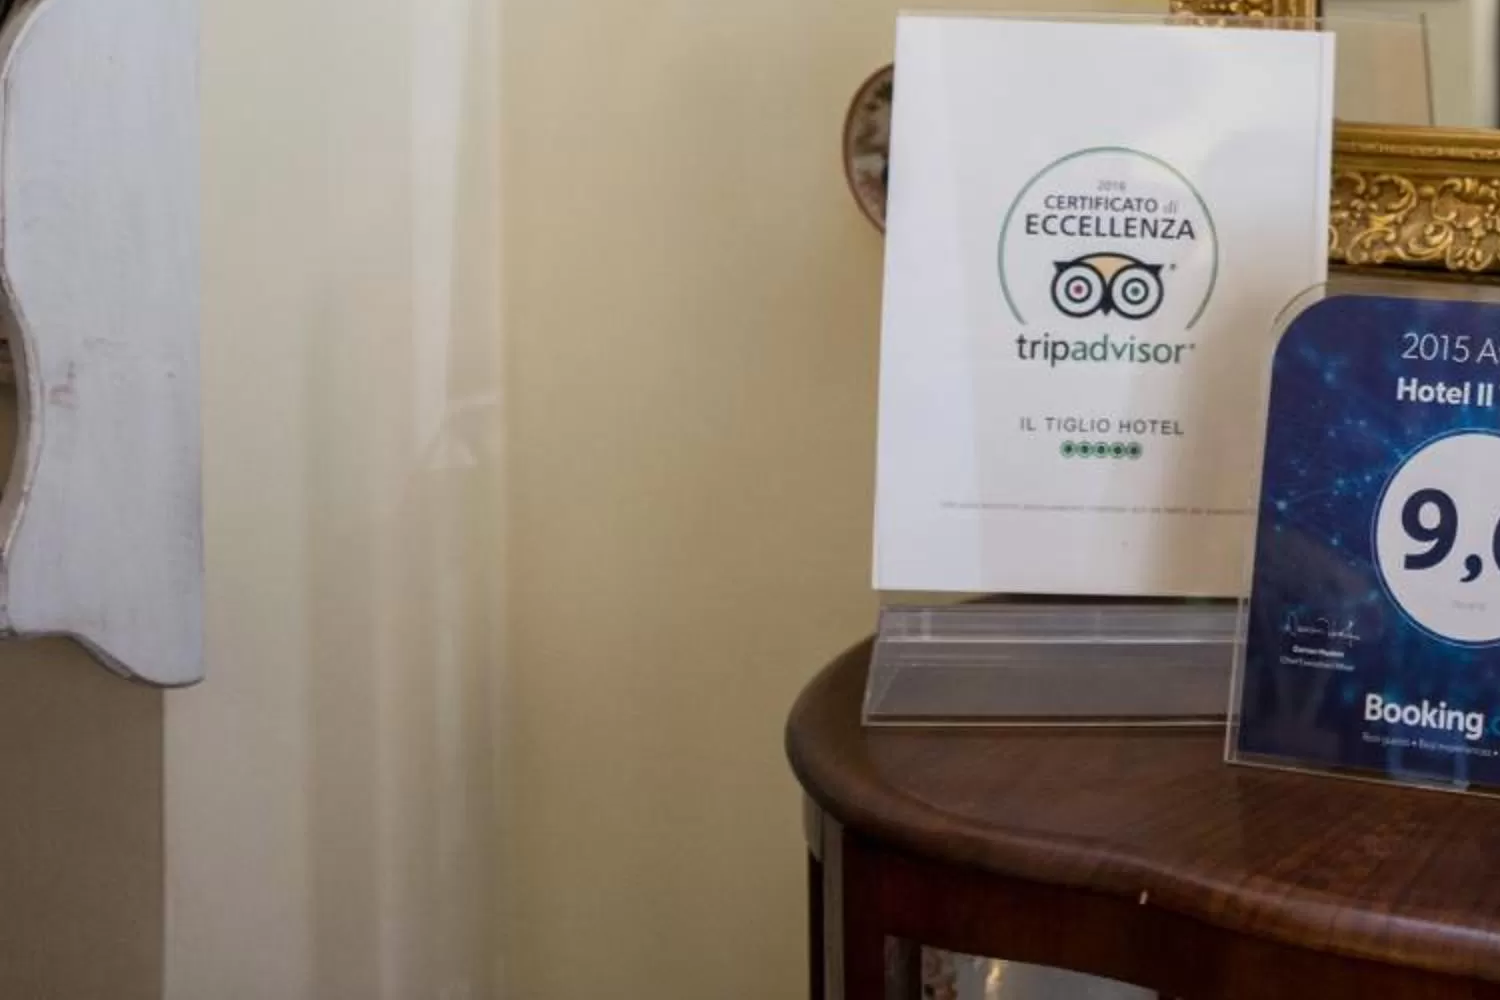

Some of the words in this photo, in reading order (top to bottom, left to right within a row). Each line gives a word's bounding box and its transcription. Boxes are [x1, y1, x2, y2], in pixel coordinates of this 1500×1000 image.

[1043, 195, 1158, 213] CERTIFICATO
[1025, 213, 1196, 240] ECCELLENZA
[1015, 332, 1186, 368] tripadvisor
[1401, 332, 1471, 363] 2015
[1396, 377, 1471, 405] Hotel
[1477, 383, 1494, 407] Il
[1019, 416, 1036, 432] IL
[1044, 416, 1111, 433] TIGLIO
[1118, 418, 1185, 436] HOTEL
